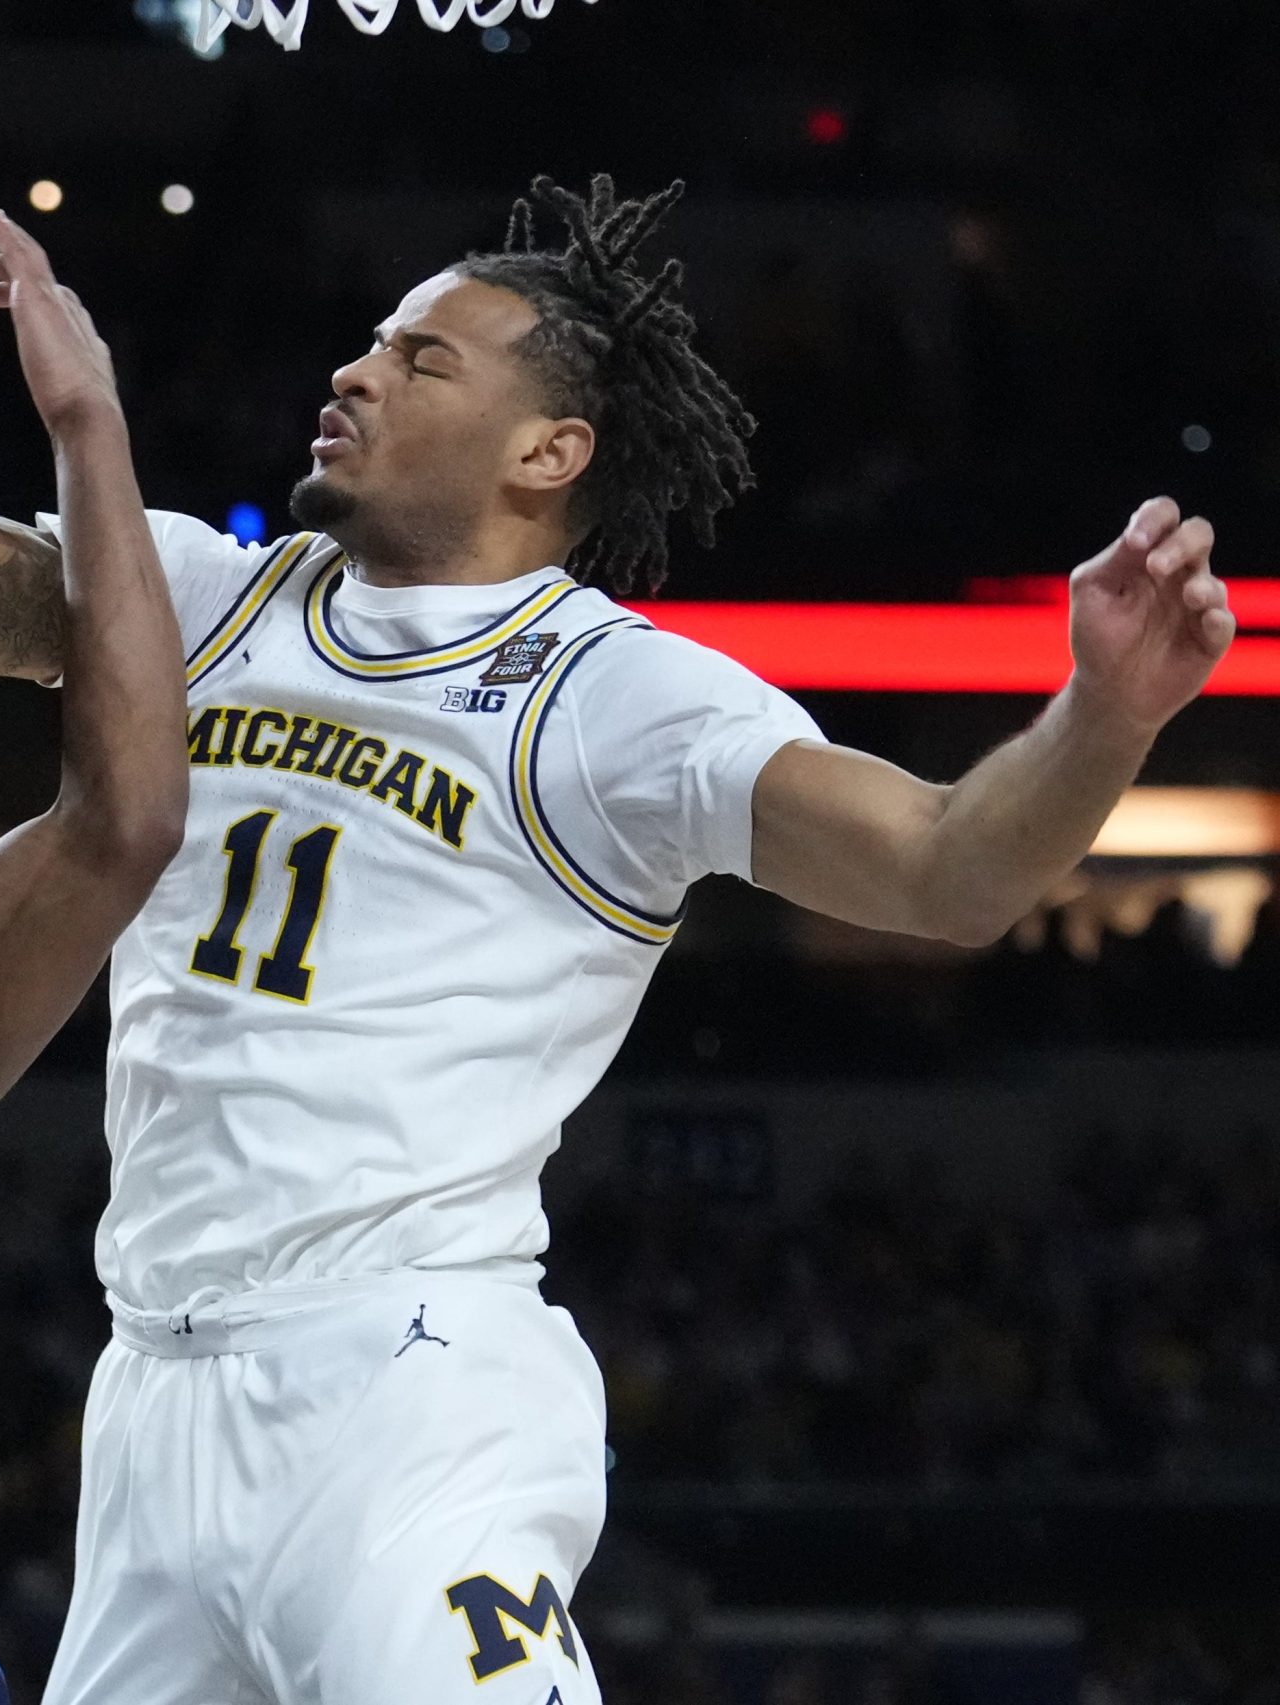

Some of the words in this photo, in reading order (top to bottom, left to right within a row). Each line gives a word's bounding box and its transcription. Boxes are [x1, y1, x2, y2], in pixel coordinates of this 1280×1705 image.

[490, 663, 533, 675] FOUR
[504, 642, 547, 656] FINAL
[189, 808, 341, 1005] 11
[443, 1571, 581, 1686] M
